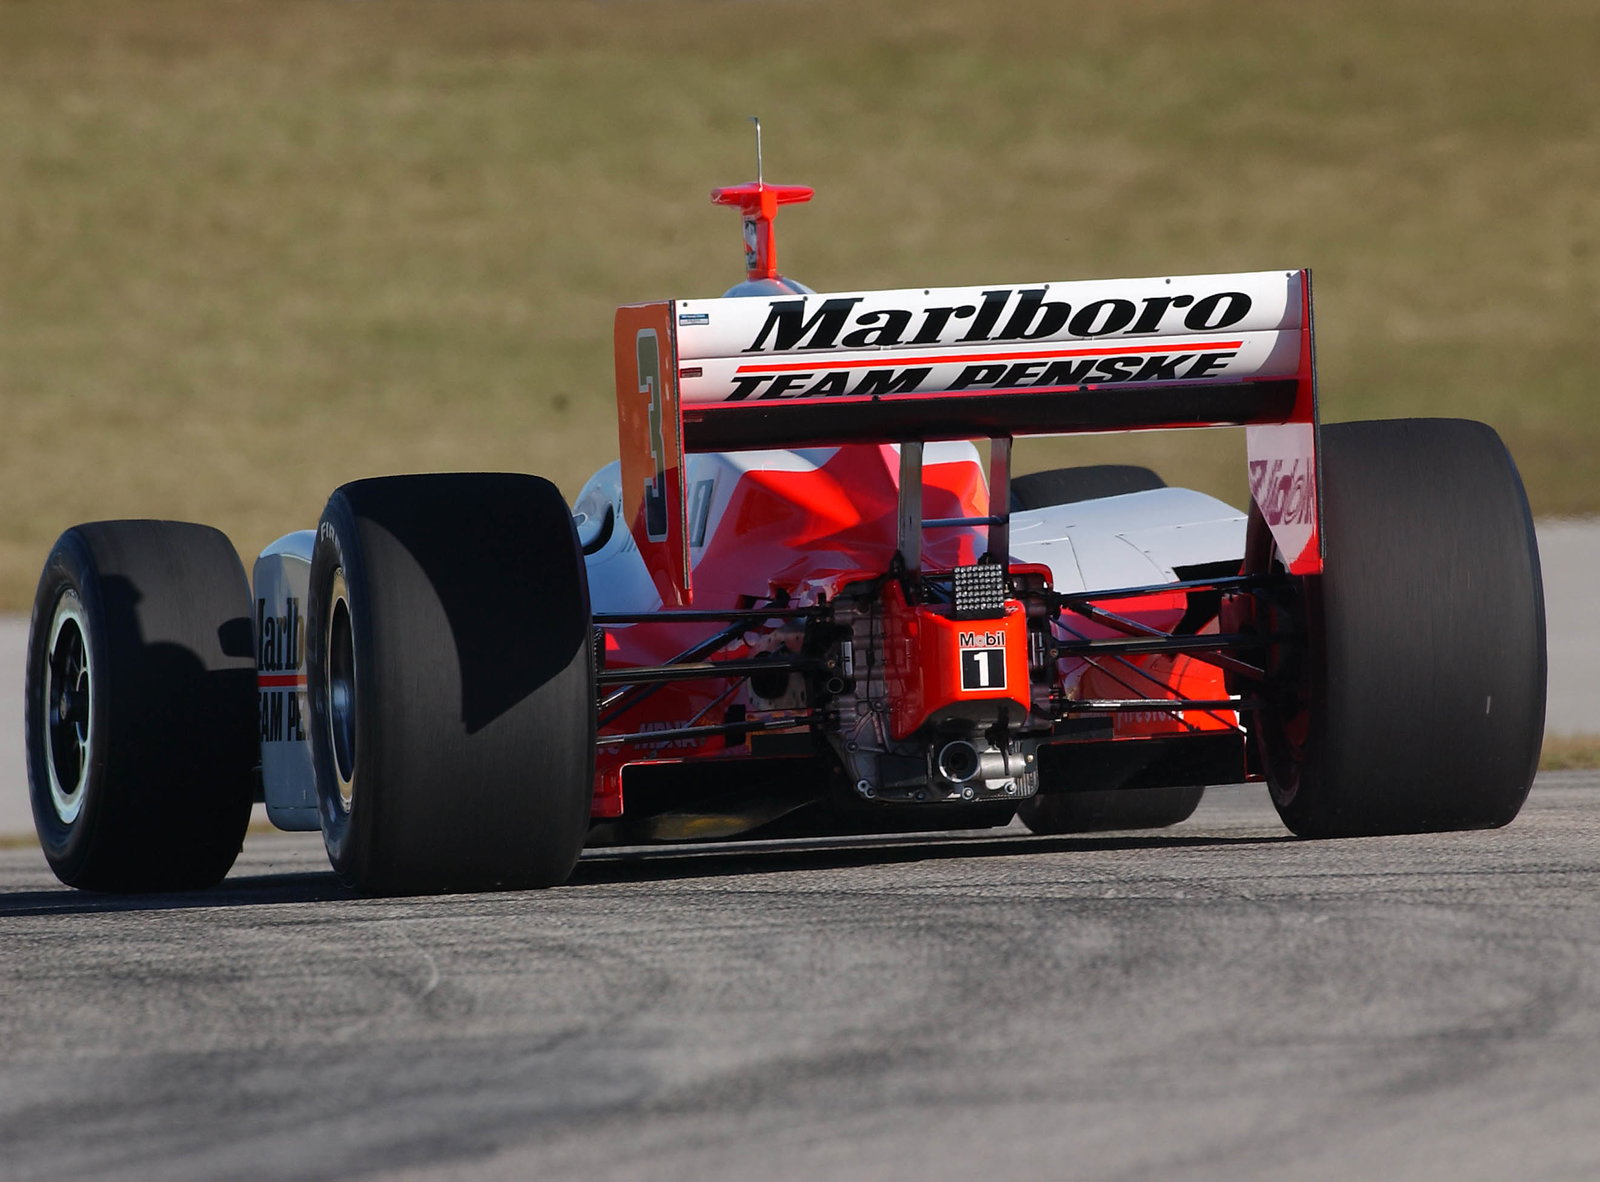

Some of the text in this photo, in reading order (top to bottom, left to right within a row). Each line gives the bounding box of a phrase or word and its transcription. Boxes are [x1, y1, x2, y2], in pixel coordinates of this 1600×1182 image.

[741, 289, 1253, 353] Marlboro
[724, 352, 1238, 401] TEAM PENSKE
[637, 328, 668, 542] 3
[959, 631, 1006, 647] Mobil
[973, 651, 990, 687] 1
